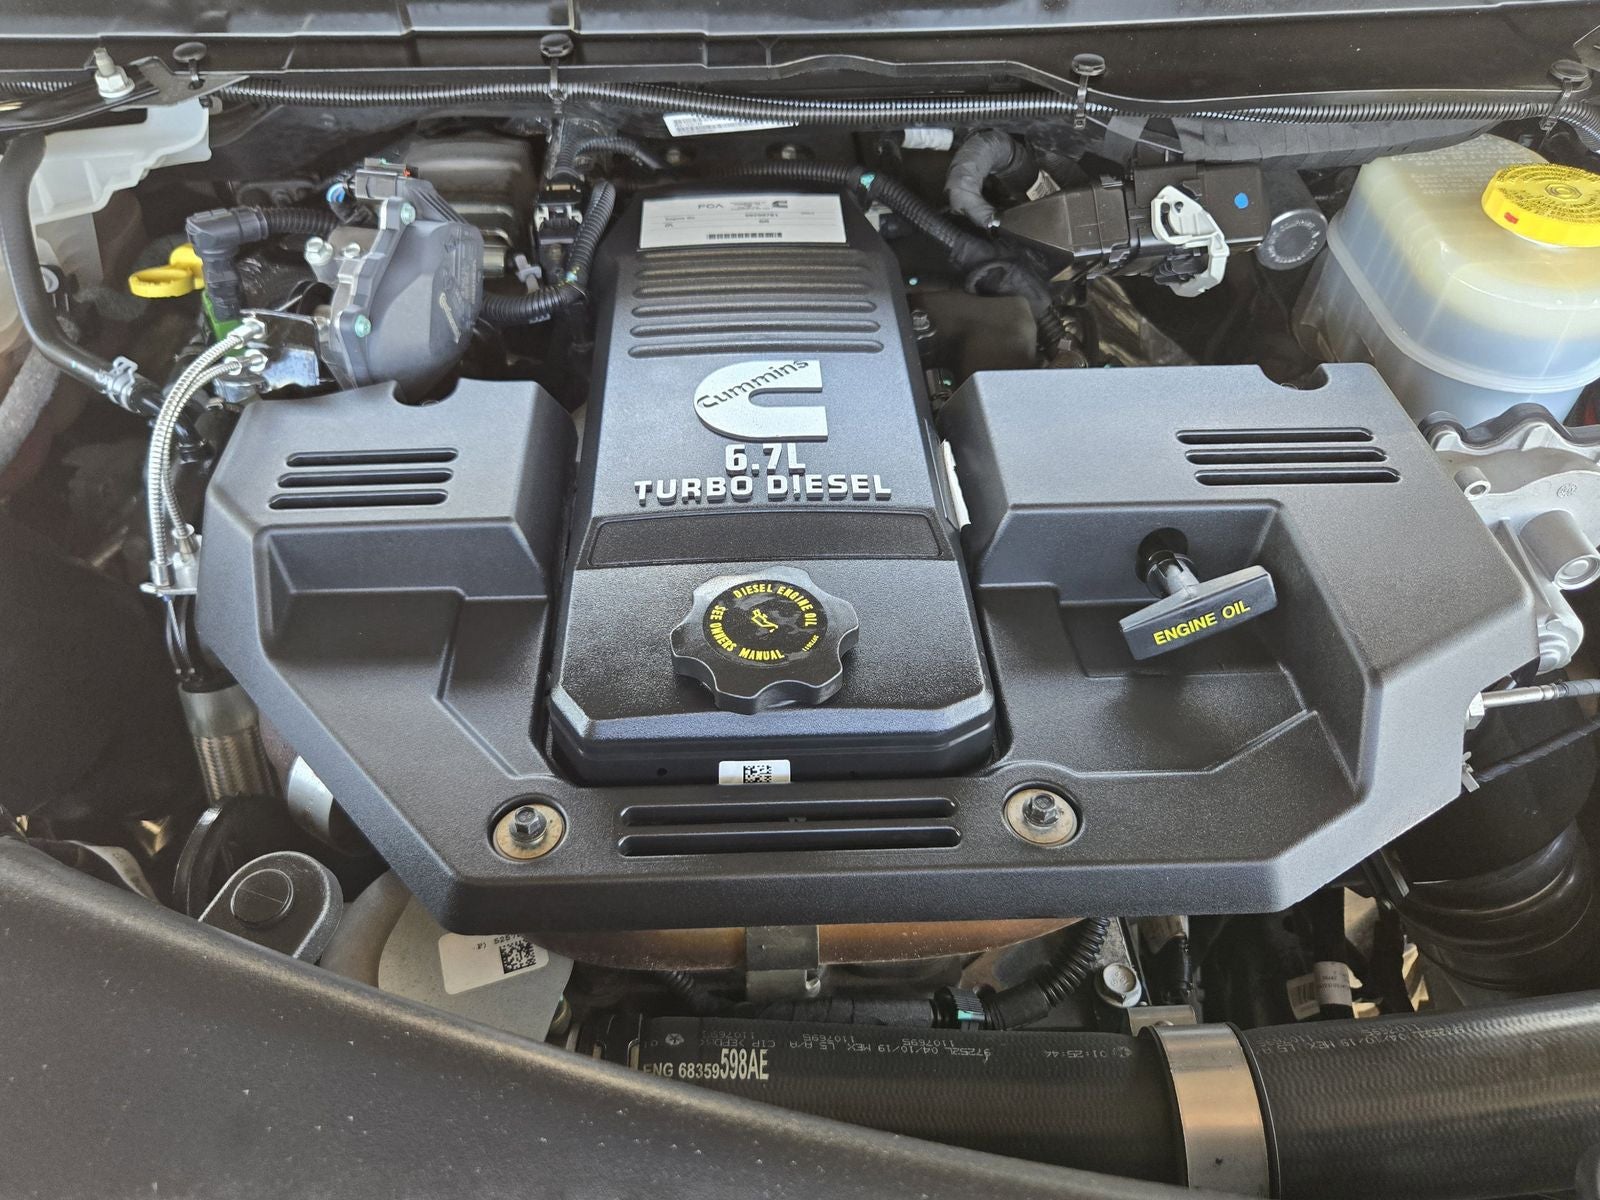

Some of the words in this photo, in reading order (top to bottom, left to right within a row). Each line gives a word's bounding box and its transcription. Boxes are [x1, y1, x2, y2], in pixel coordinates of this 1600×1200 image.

[696, 360, 809, 409] Cummins
[725, 442, 806, 475] 6.7L
[634, 476, 753, 505] TURBO
[767, 474, 892, 501] DIESEL
[709, 604, 728, 621] SEE
[732, 584, 773, 599] DIESEL
[777, 586, 814, 612] ENGINE
[804, 612, 818, 627] OIL
[709, 622, 737, 652] OWNERS
[1153, 612, 1218, 646] ENGINE
[1222, 600, 1251, 619] OIL
[738, 647, 785, 661] MANUAL
[847, 1042, 871, 1052] MEX
[877, 1044, 938, 1055] 04/10/19
[643, 1062, 674, 1078] ENG
